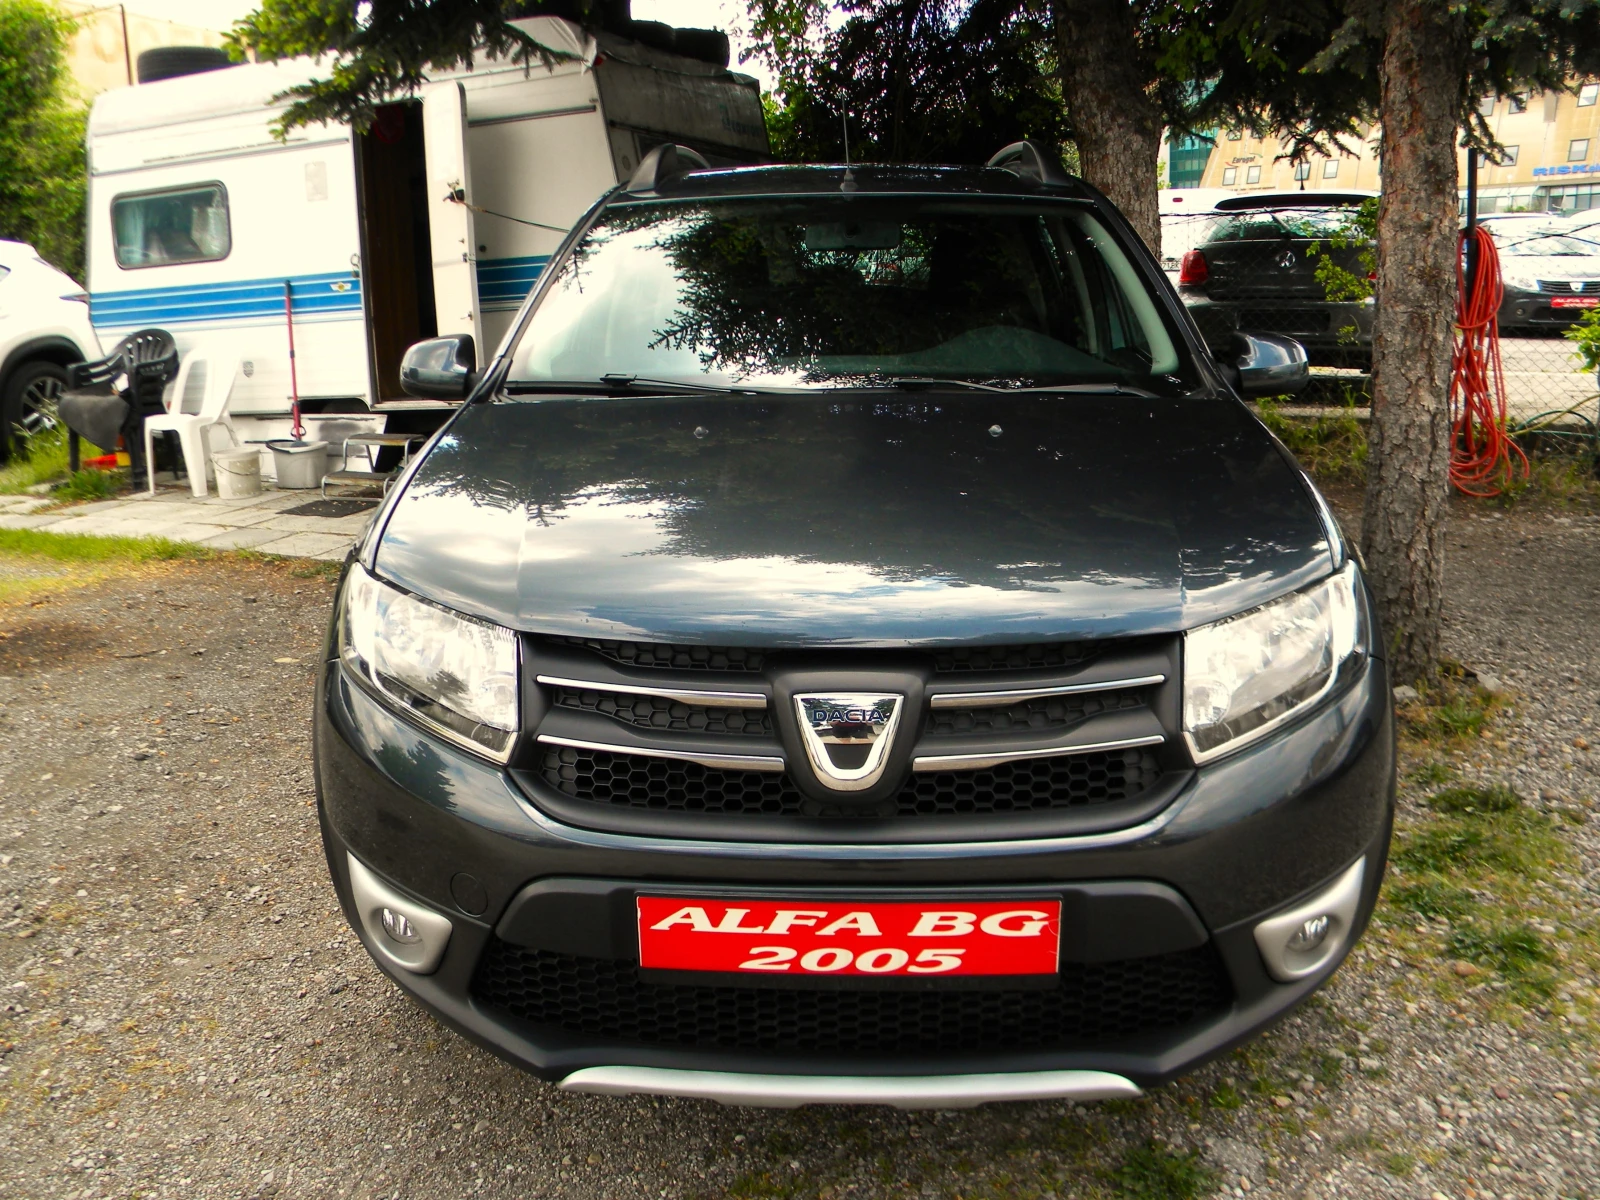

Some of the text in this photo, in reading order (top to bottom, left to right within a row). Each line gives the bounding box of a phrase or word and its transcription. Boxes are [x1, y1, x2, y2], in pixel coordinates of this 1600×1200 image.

[812, 709, 886, 723] DACIA
[651, 906, 1049, 938] ALFA BG
[738, 946, 967, 974] 2005
